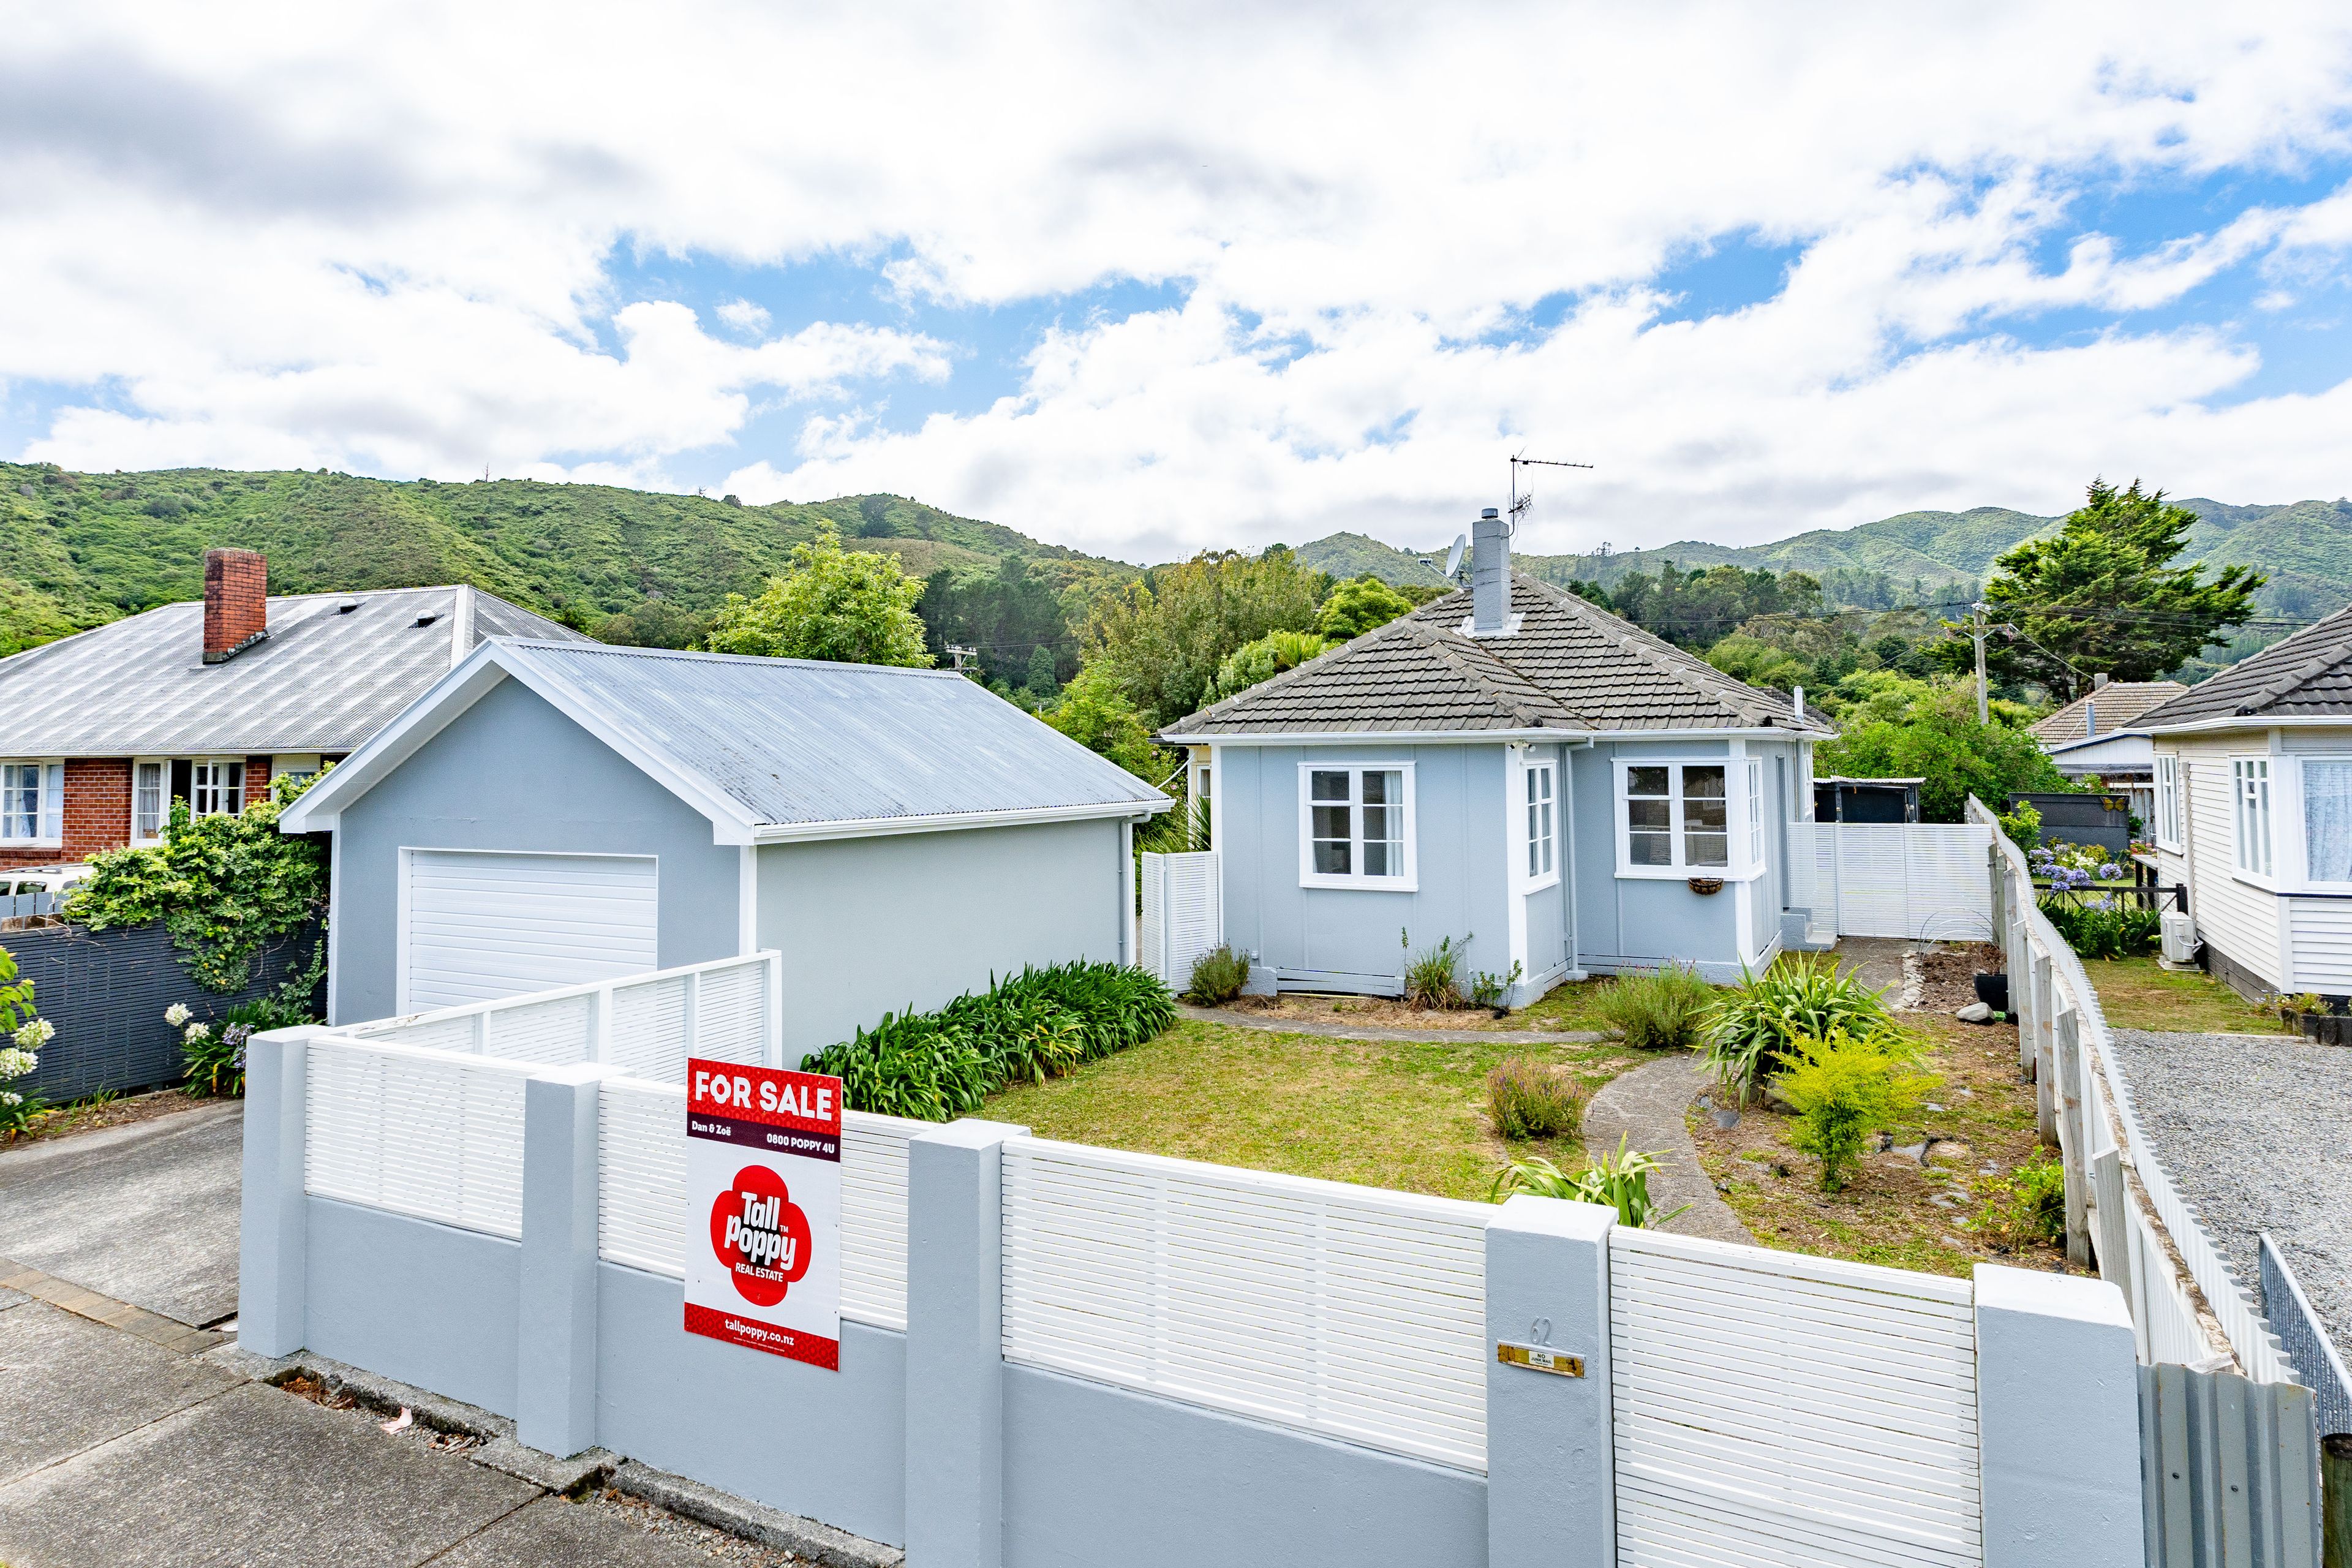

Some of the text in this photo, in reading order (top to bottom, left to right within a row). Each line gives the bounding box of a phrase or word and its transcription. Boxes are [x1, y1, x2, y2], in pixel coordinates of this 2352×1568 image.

[696, 1071, 832, 1121] FOR SALE
[692, 1122, 731, 1136] Dan & Zoë
[767, 1133, 834, 1153] 0800 POPPY 4U
[741, 1191, 780, 1232] Tall
[736, 1262, 783, 1283] REAL ESTATE
[725, 1319, 794, 1345] tallpoppy.co.nz
[1529, 1316, 1551, 1347] 62
